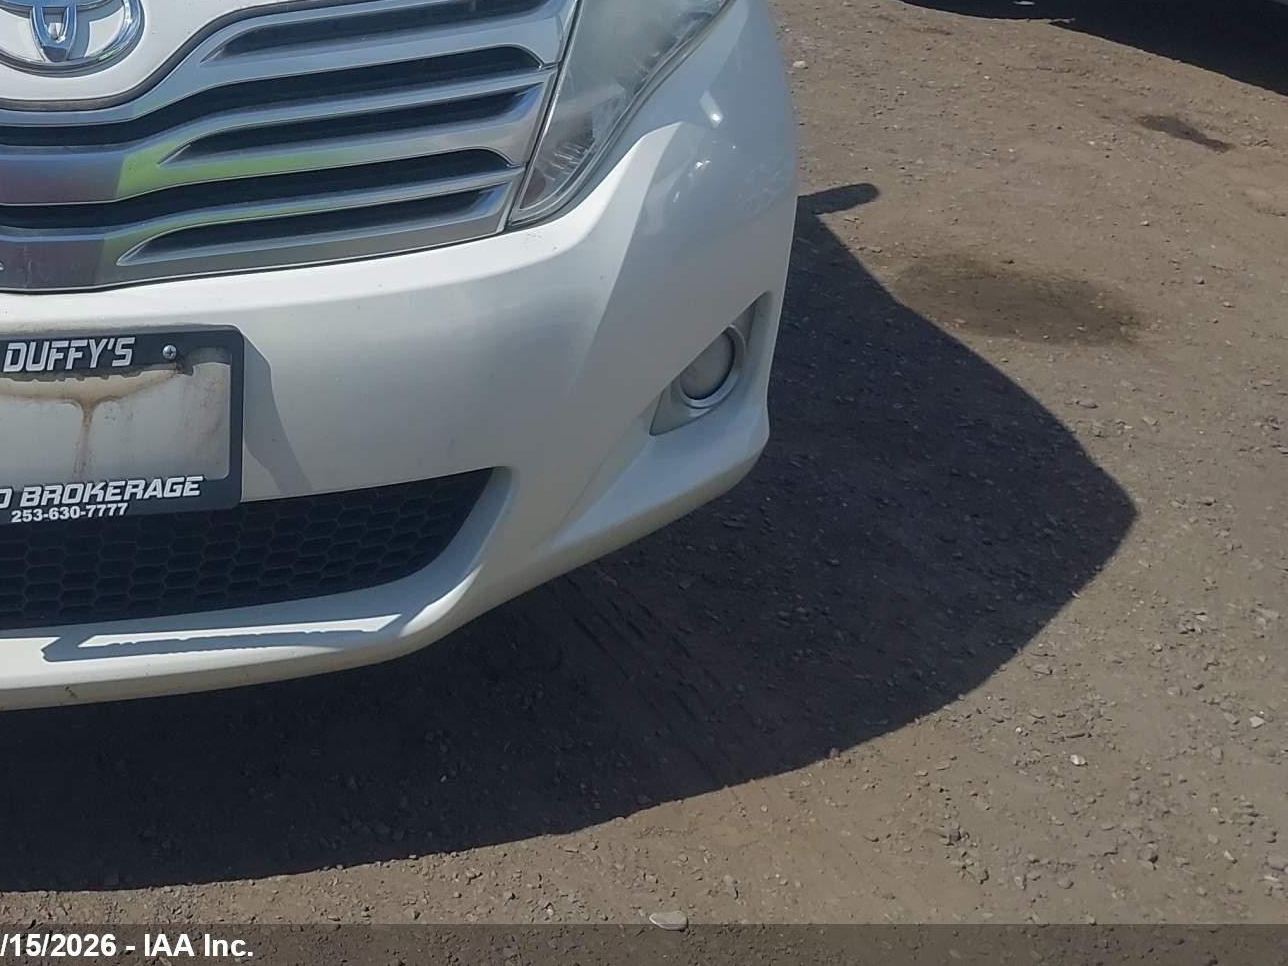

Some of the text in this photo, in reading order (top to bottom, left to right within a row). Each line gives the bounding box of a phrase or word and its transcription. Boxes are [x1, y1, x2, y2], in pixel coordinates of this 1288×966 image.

[2, 336, 136, 373] DUFFY'S
[19, 475, 204, 508] BROKERAGE
[11, 502, 129, 524] 253-630-7777
